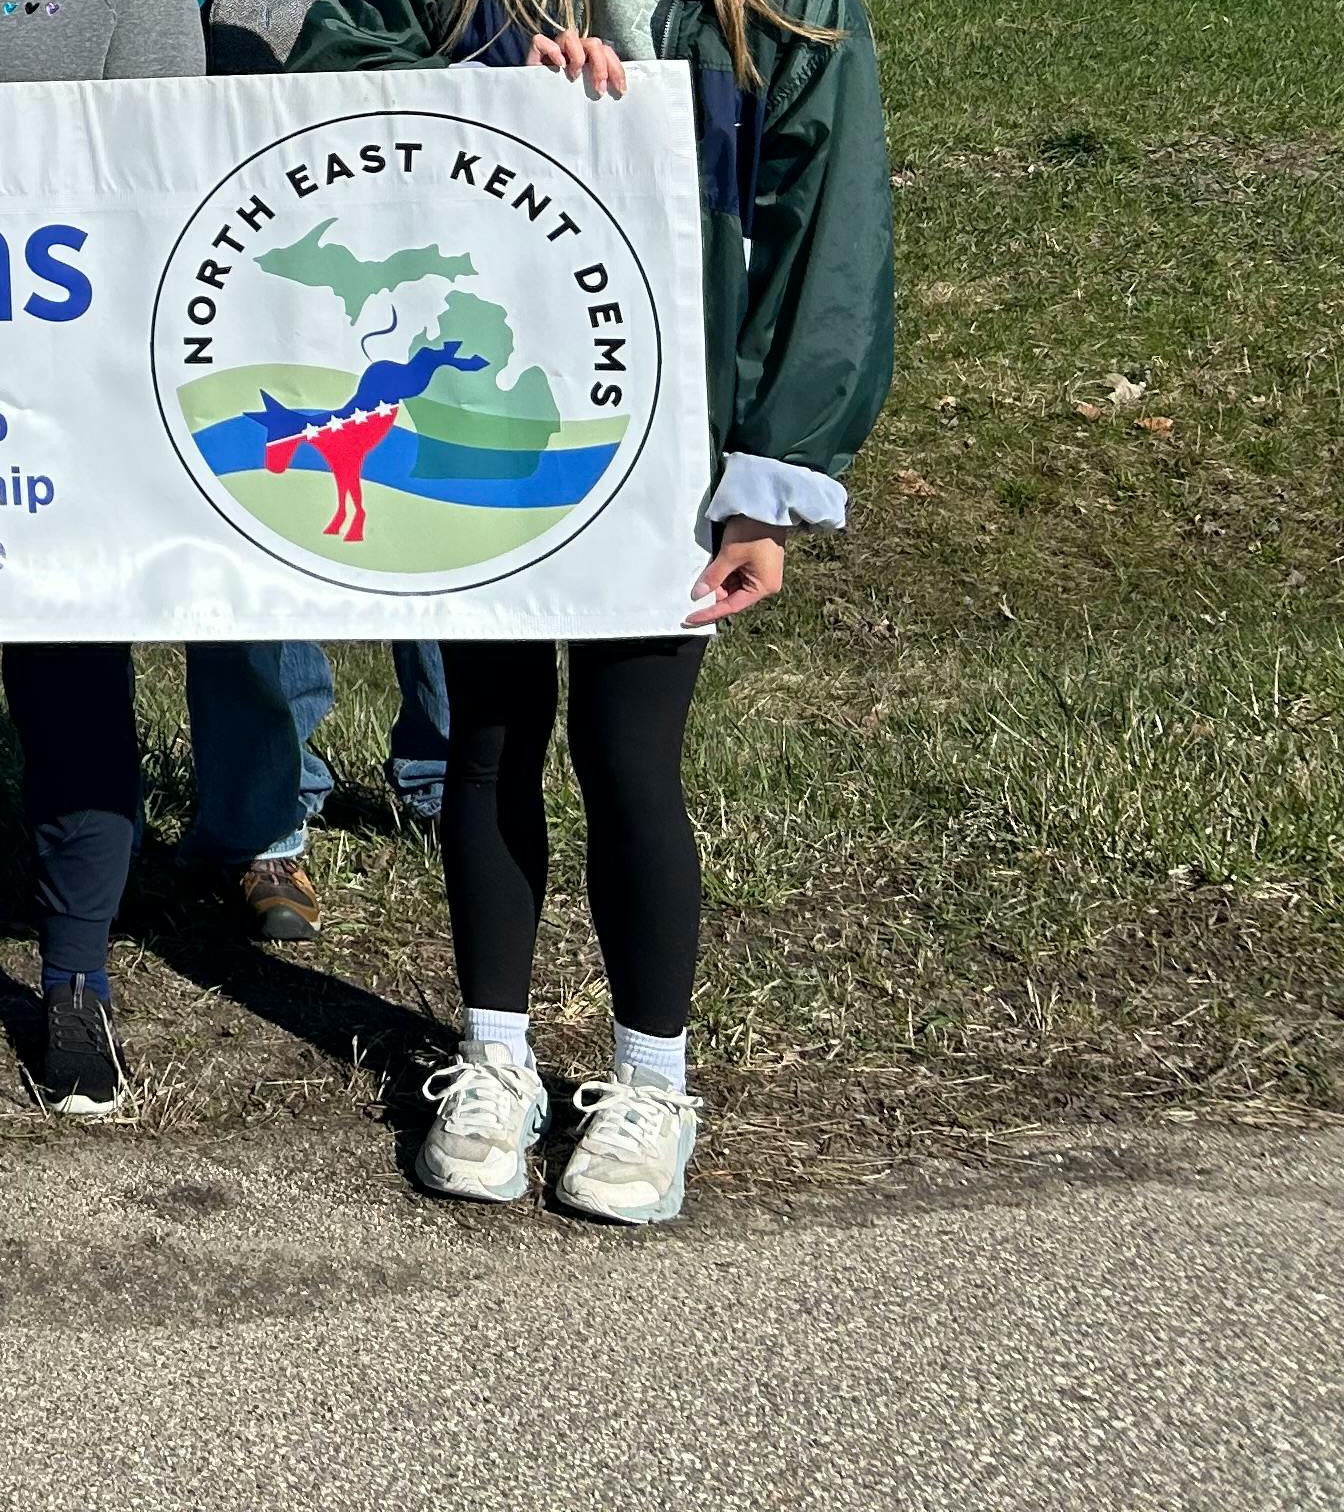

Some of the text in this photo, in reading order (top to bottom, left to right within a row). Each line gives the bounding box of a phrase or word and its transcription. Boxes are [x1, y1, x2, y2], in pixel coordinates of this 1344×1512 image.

[183, 143, 626, 407] NORTH EAST KENT DEMS
